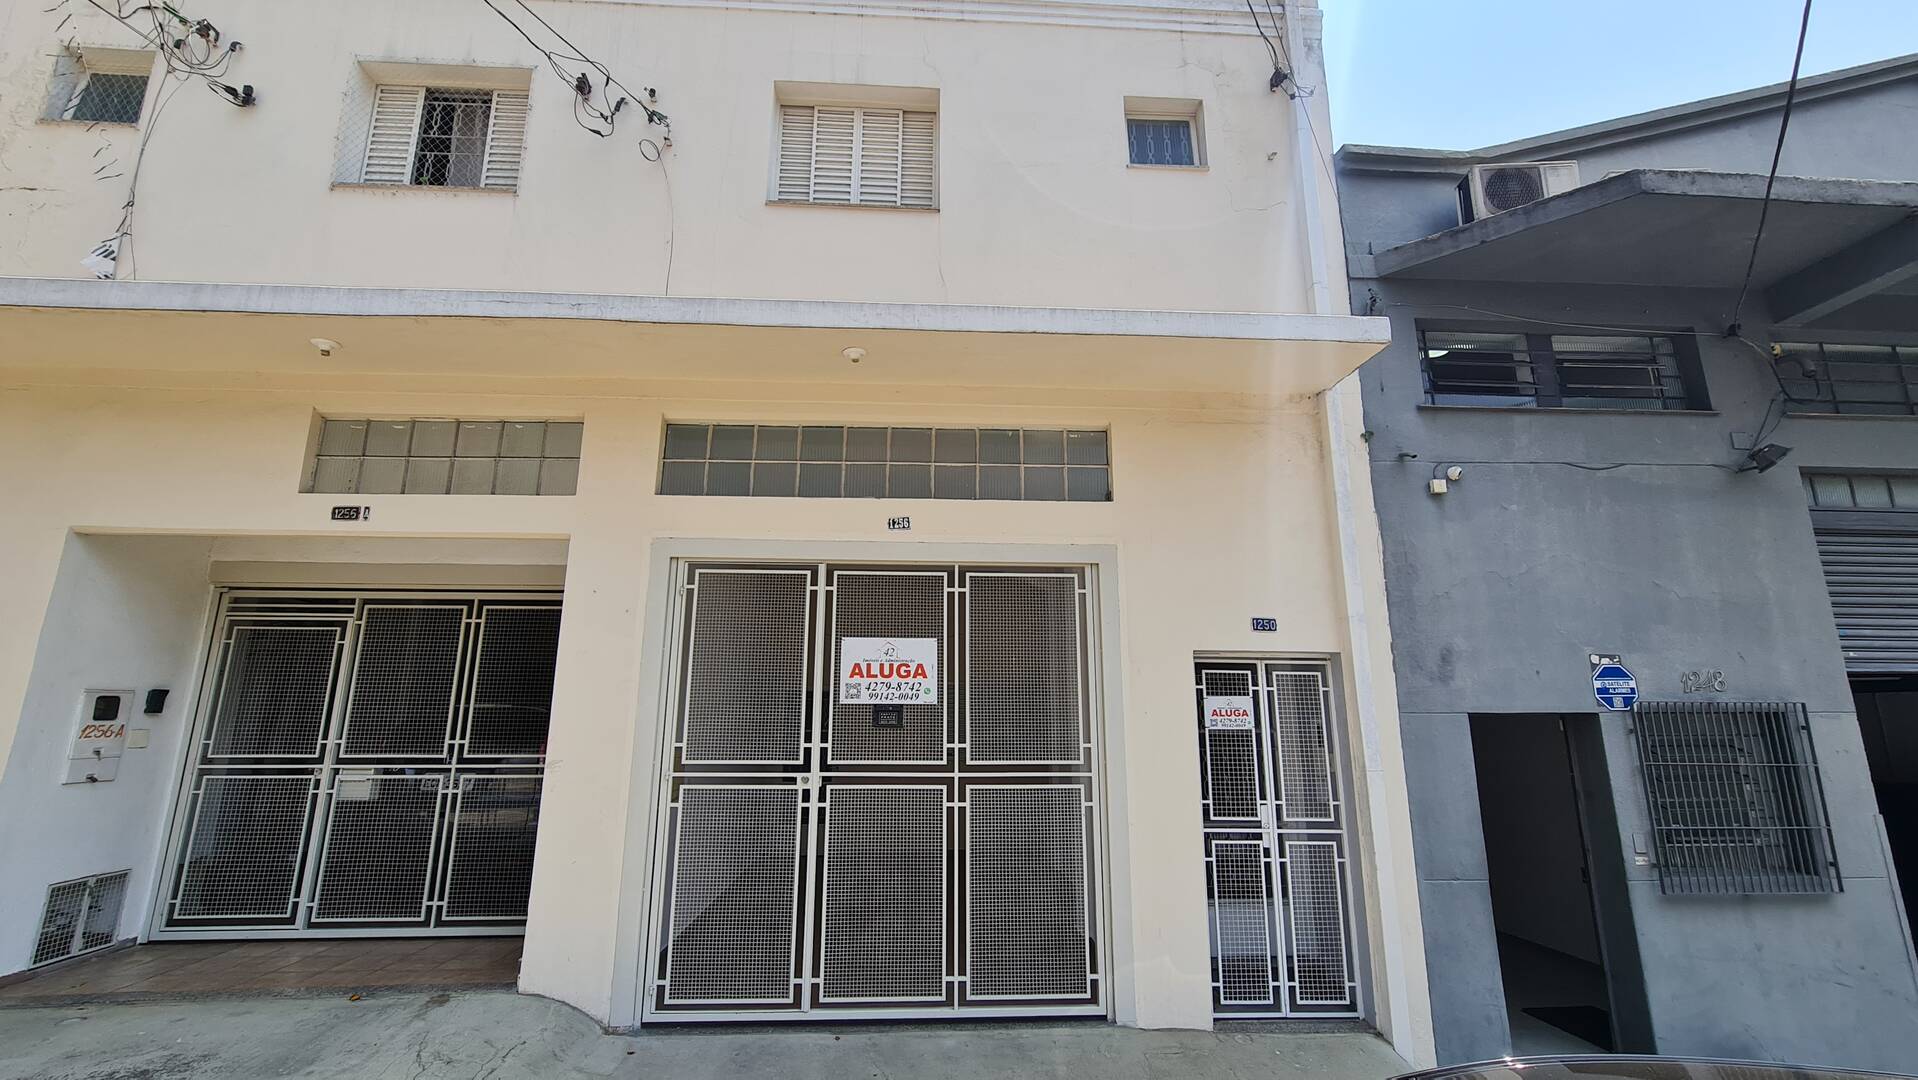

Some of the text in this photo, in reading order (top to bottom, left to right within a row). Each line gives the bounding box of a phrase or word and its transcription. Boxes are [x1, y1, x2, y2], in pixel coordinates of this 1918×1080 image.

[334, 508, 357, 519] 1256
[889, 518, 909, 529] 1256
[1253, 619, 1276, 630] 1250
[883, 647, 895, 657] 42
[849, 663, 928, 679] ALUGA
[865, 681, 922, 692] 4279-8742
[1681, 670, 1727, 693] 1248
[868, 692, 920, 701] 99142-0049
[1211, 709, 1249, 717] ALUGA
